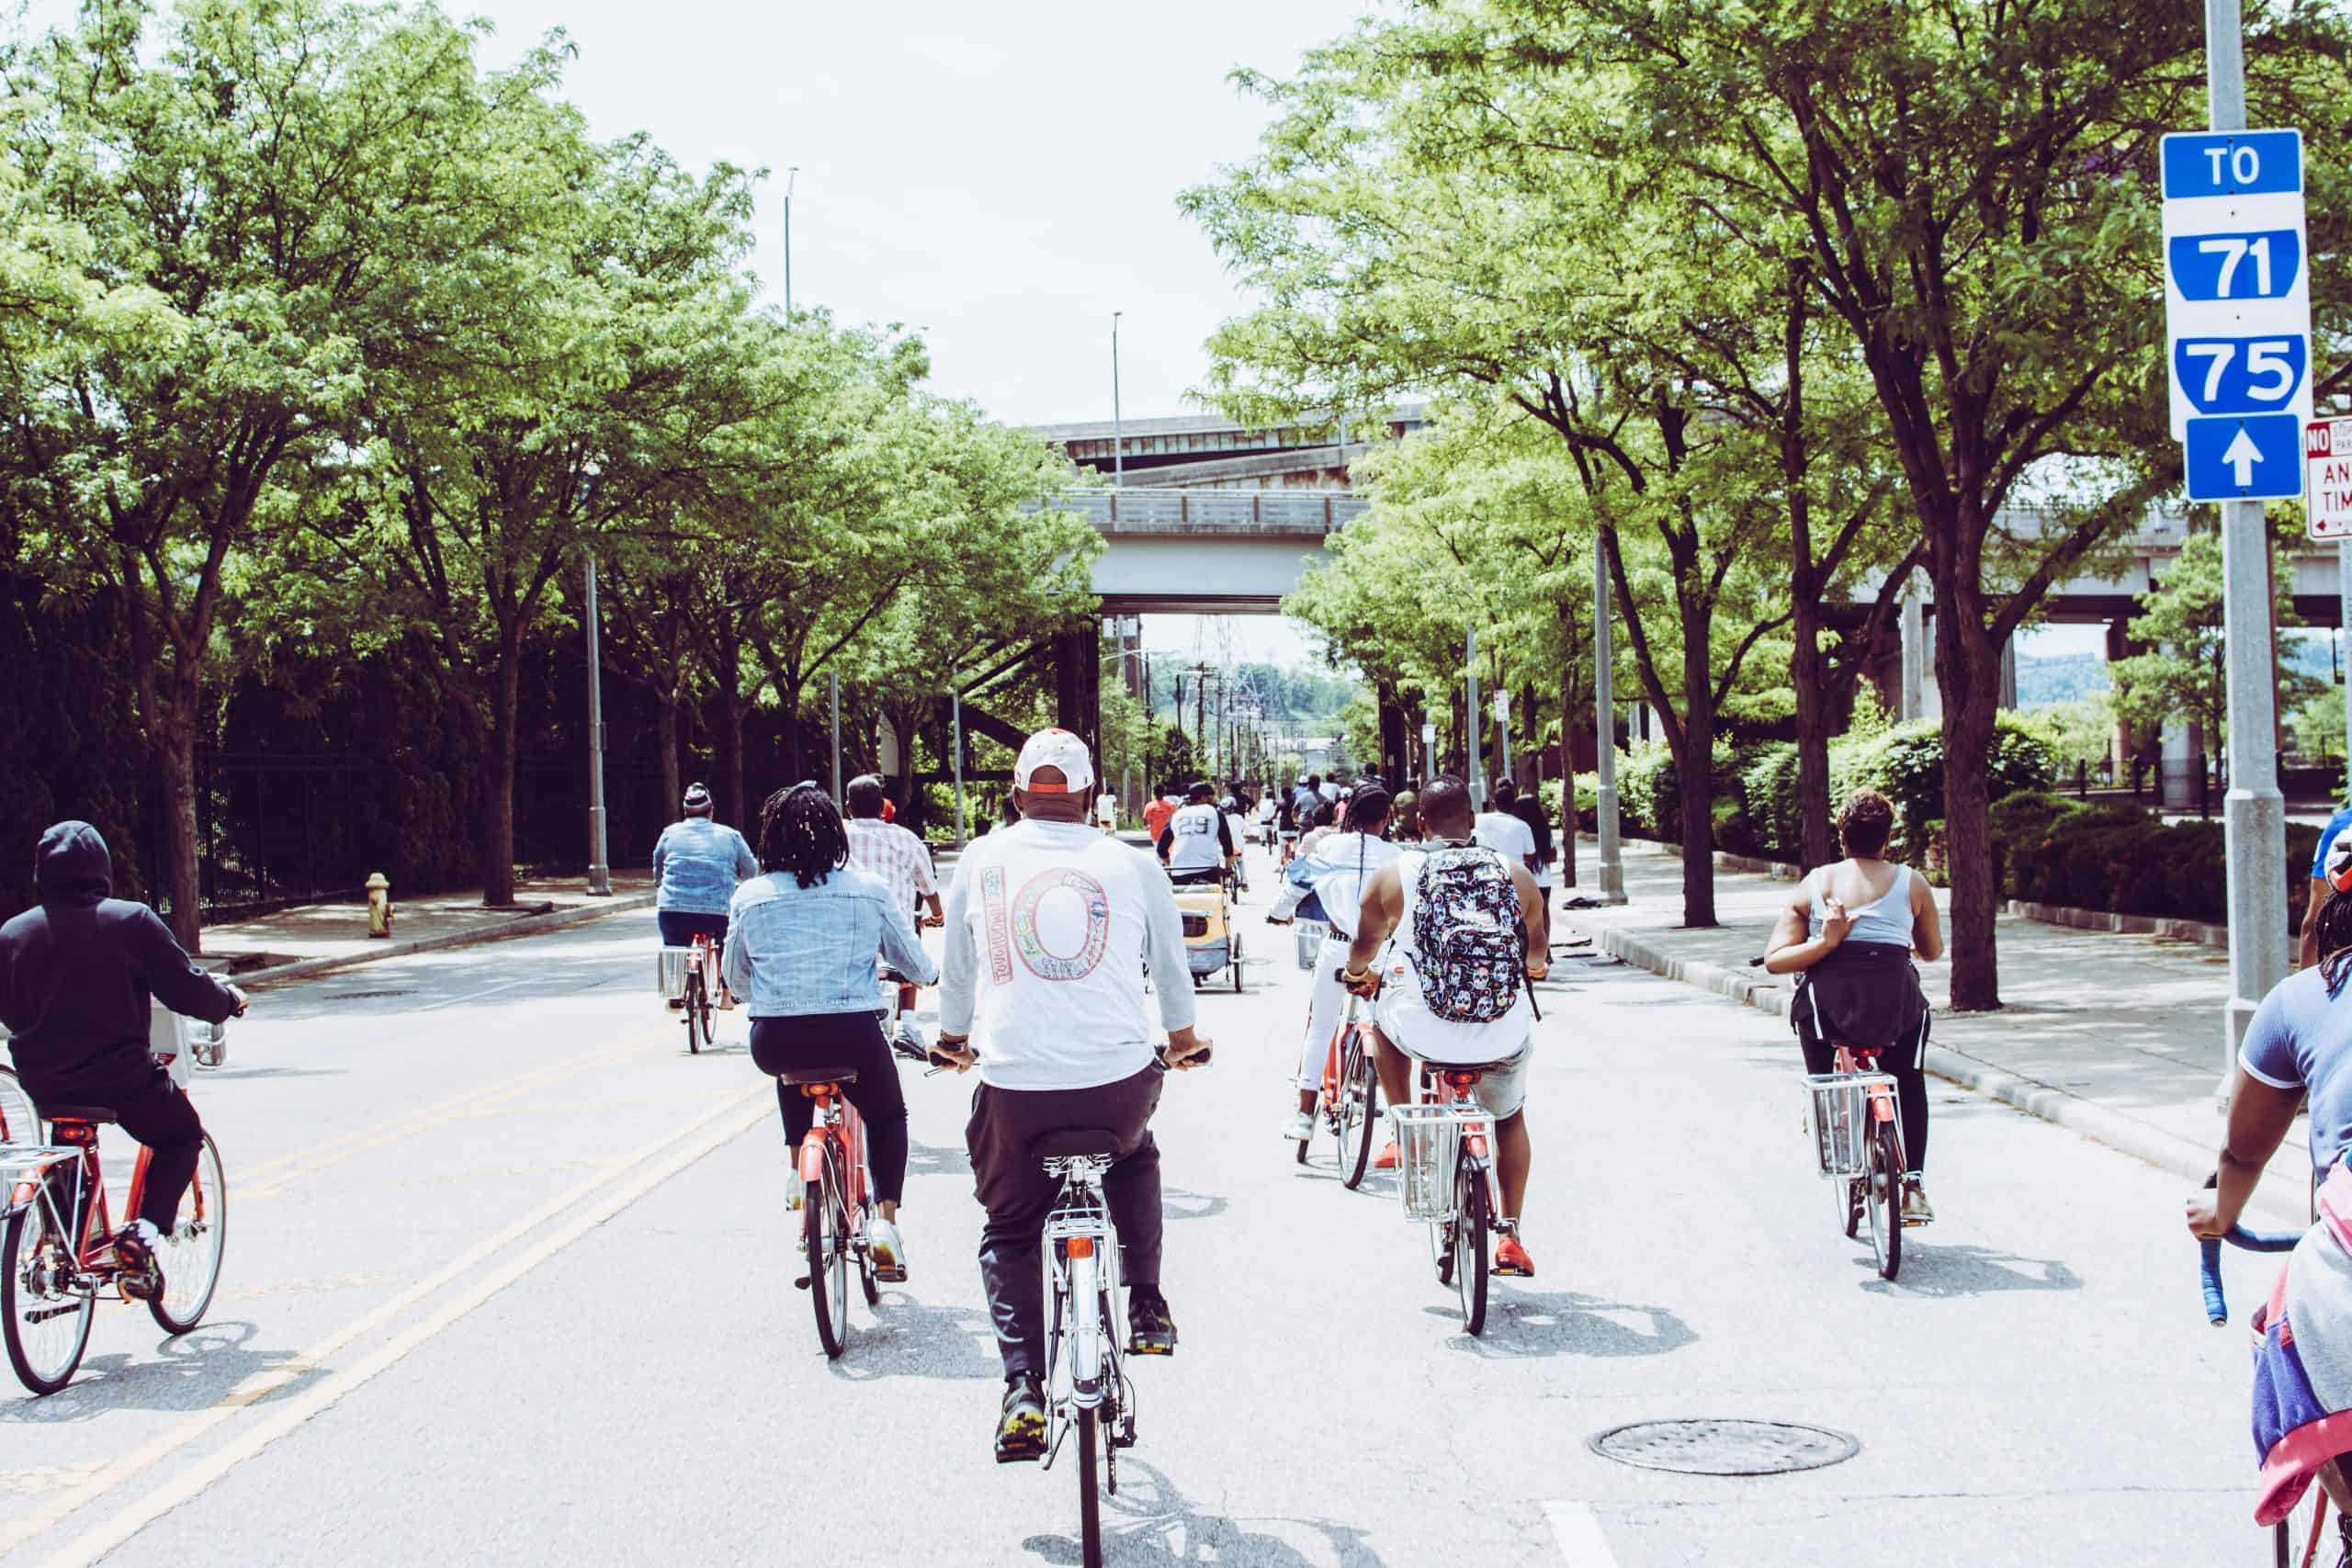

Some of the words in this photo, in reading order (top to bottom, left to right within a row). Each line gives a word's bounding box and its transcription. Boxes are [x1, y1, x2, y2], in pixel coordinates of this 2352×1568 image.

[2204, 146, 2259, 185] TO
[2199, 237, 2271, 298] 71
[2187, 341, 2294, 401] 75
[2308, 428, 2329, 451] NO
[2336, 439, 2352, 449] PAR
[2324, 462, 2350, 484] AN
[2323, 490, 2352, 513] TIM
[1179, 816, 1209, 836] 29
